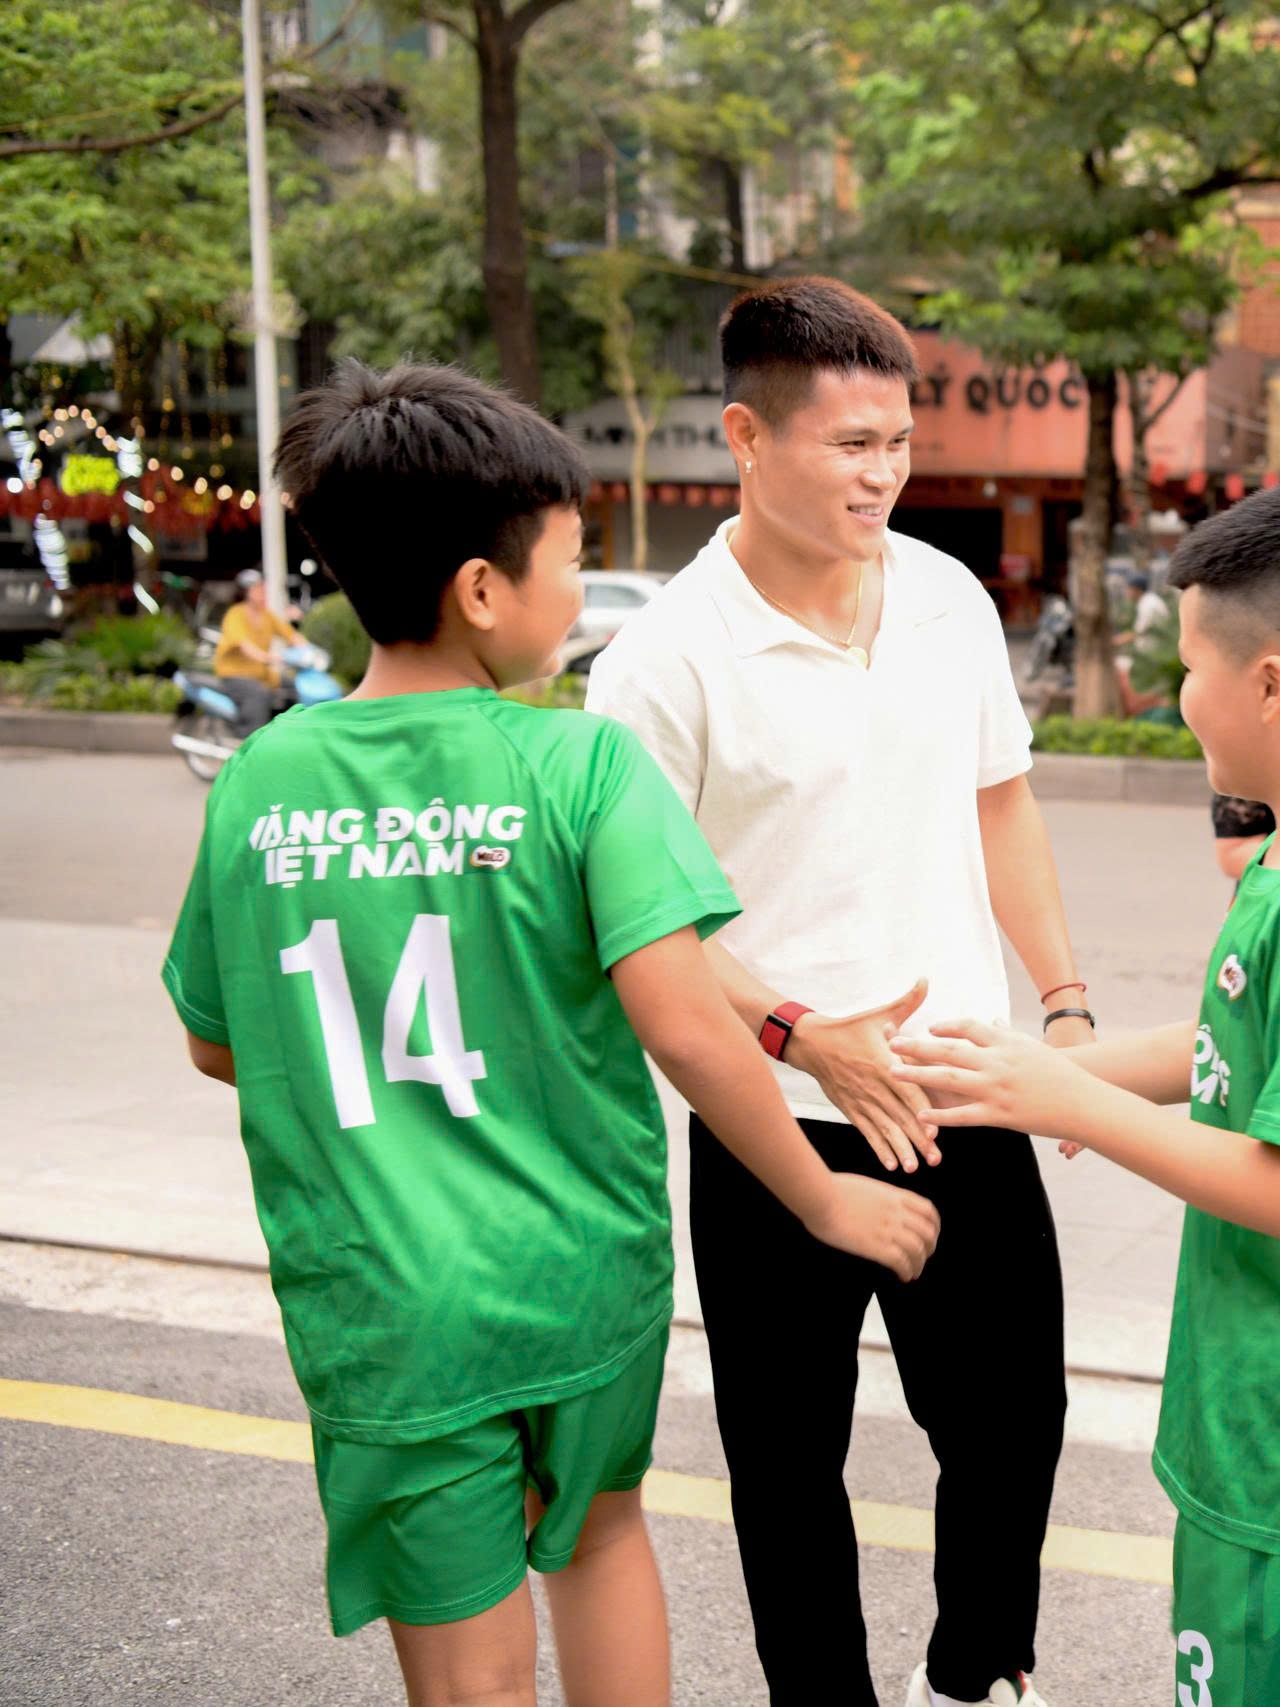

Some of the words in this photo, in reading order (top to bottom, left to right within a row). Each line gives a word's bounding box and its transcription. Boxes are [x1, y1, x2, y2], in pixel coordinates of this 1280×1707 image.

[348, 840, 464, 878] NAM
[279, 914, 487, 1129] 14
[1178, 1630, 1213, 1707] 3
